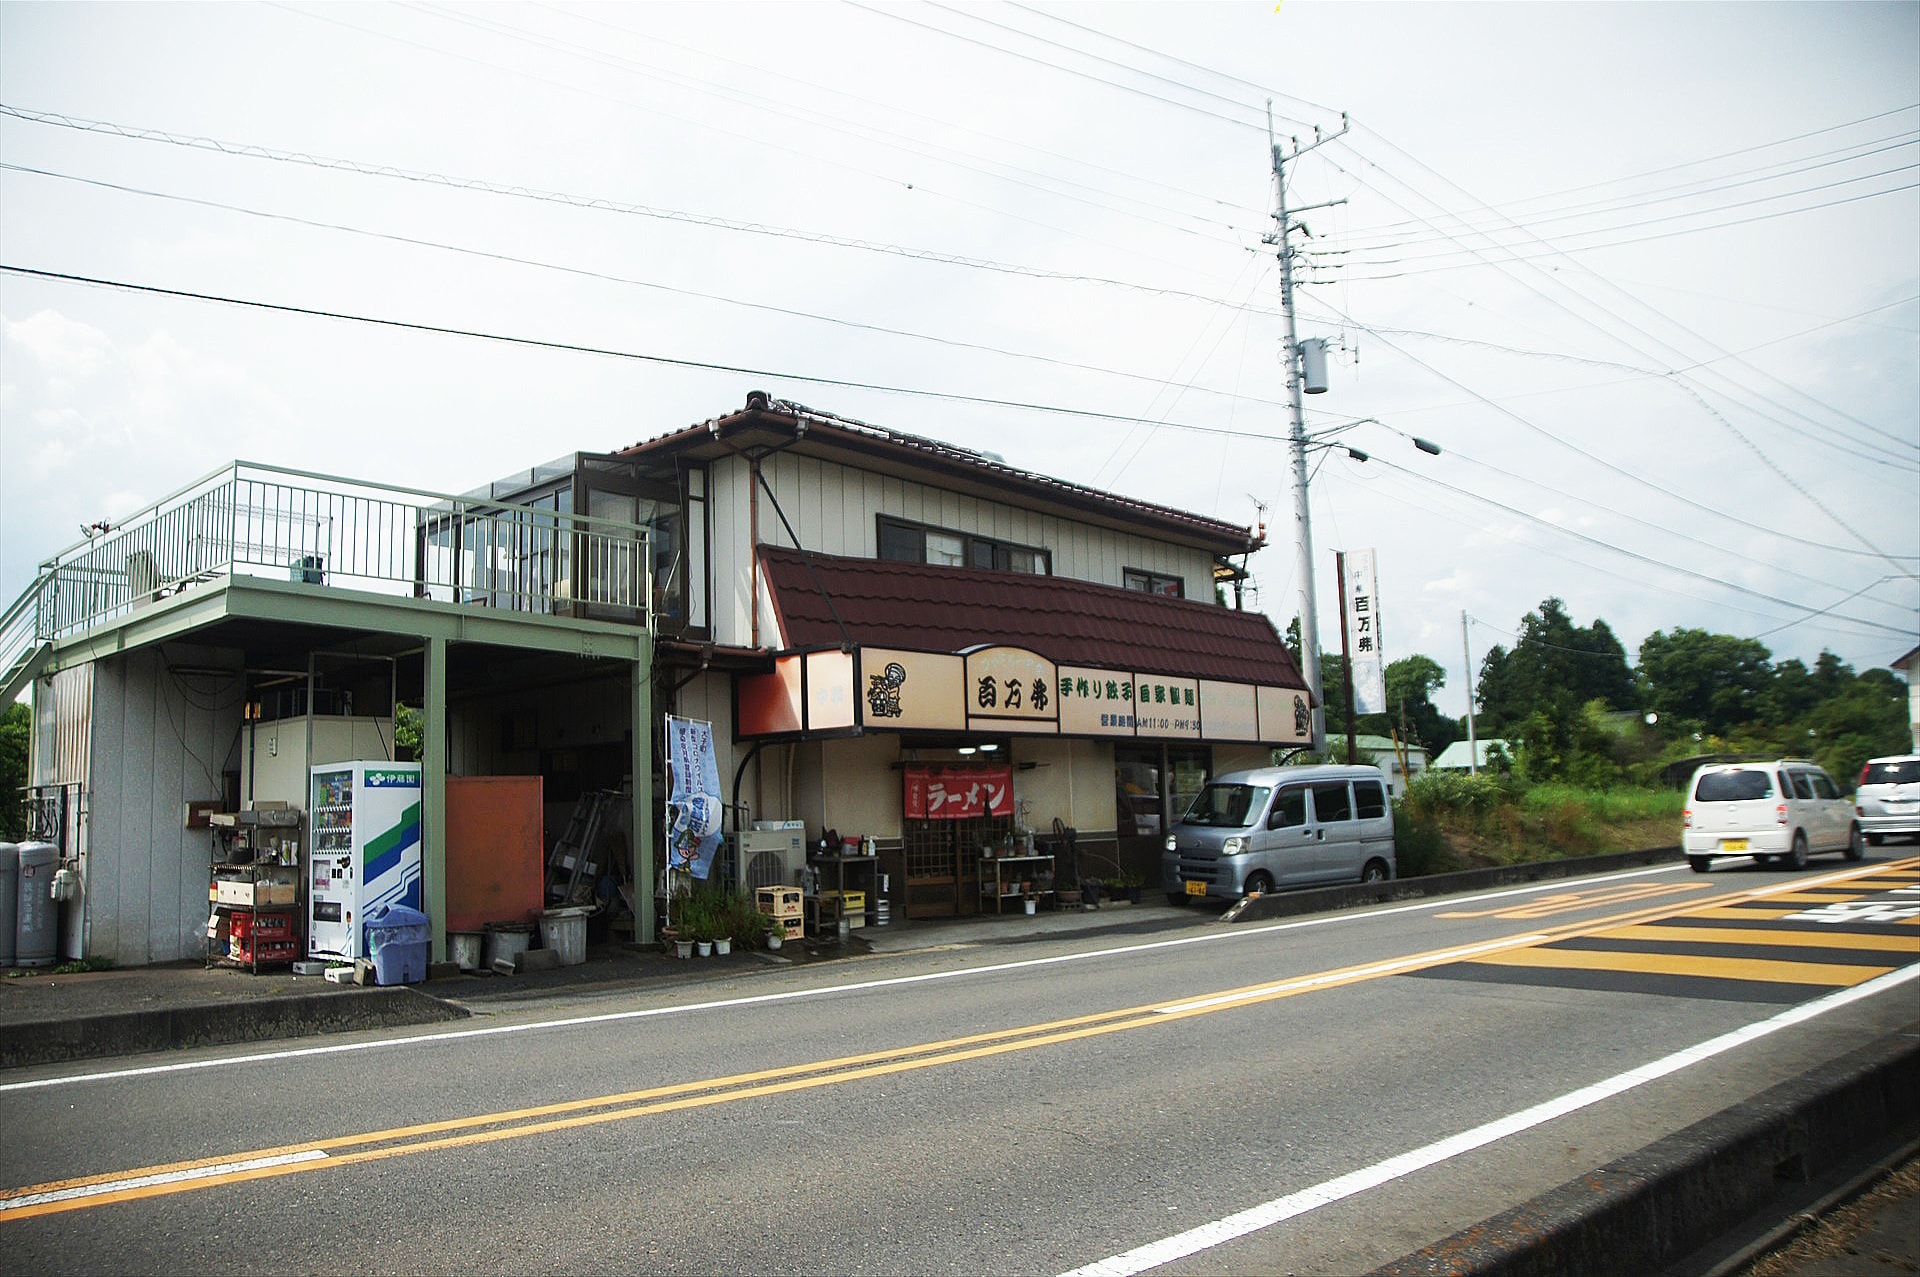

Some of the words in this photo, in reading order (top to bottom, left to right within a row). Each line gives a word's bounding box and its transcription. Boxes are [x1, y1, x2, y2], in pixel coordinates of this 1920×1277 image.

[977, 675, 1049, 711] 百万弗
[1060, 676, 1132, 702] 手作り餃子
[1139, 683, 1195, 706] 自家製麺
[927, 781, 1006, 812] ラーメン
